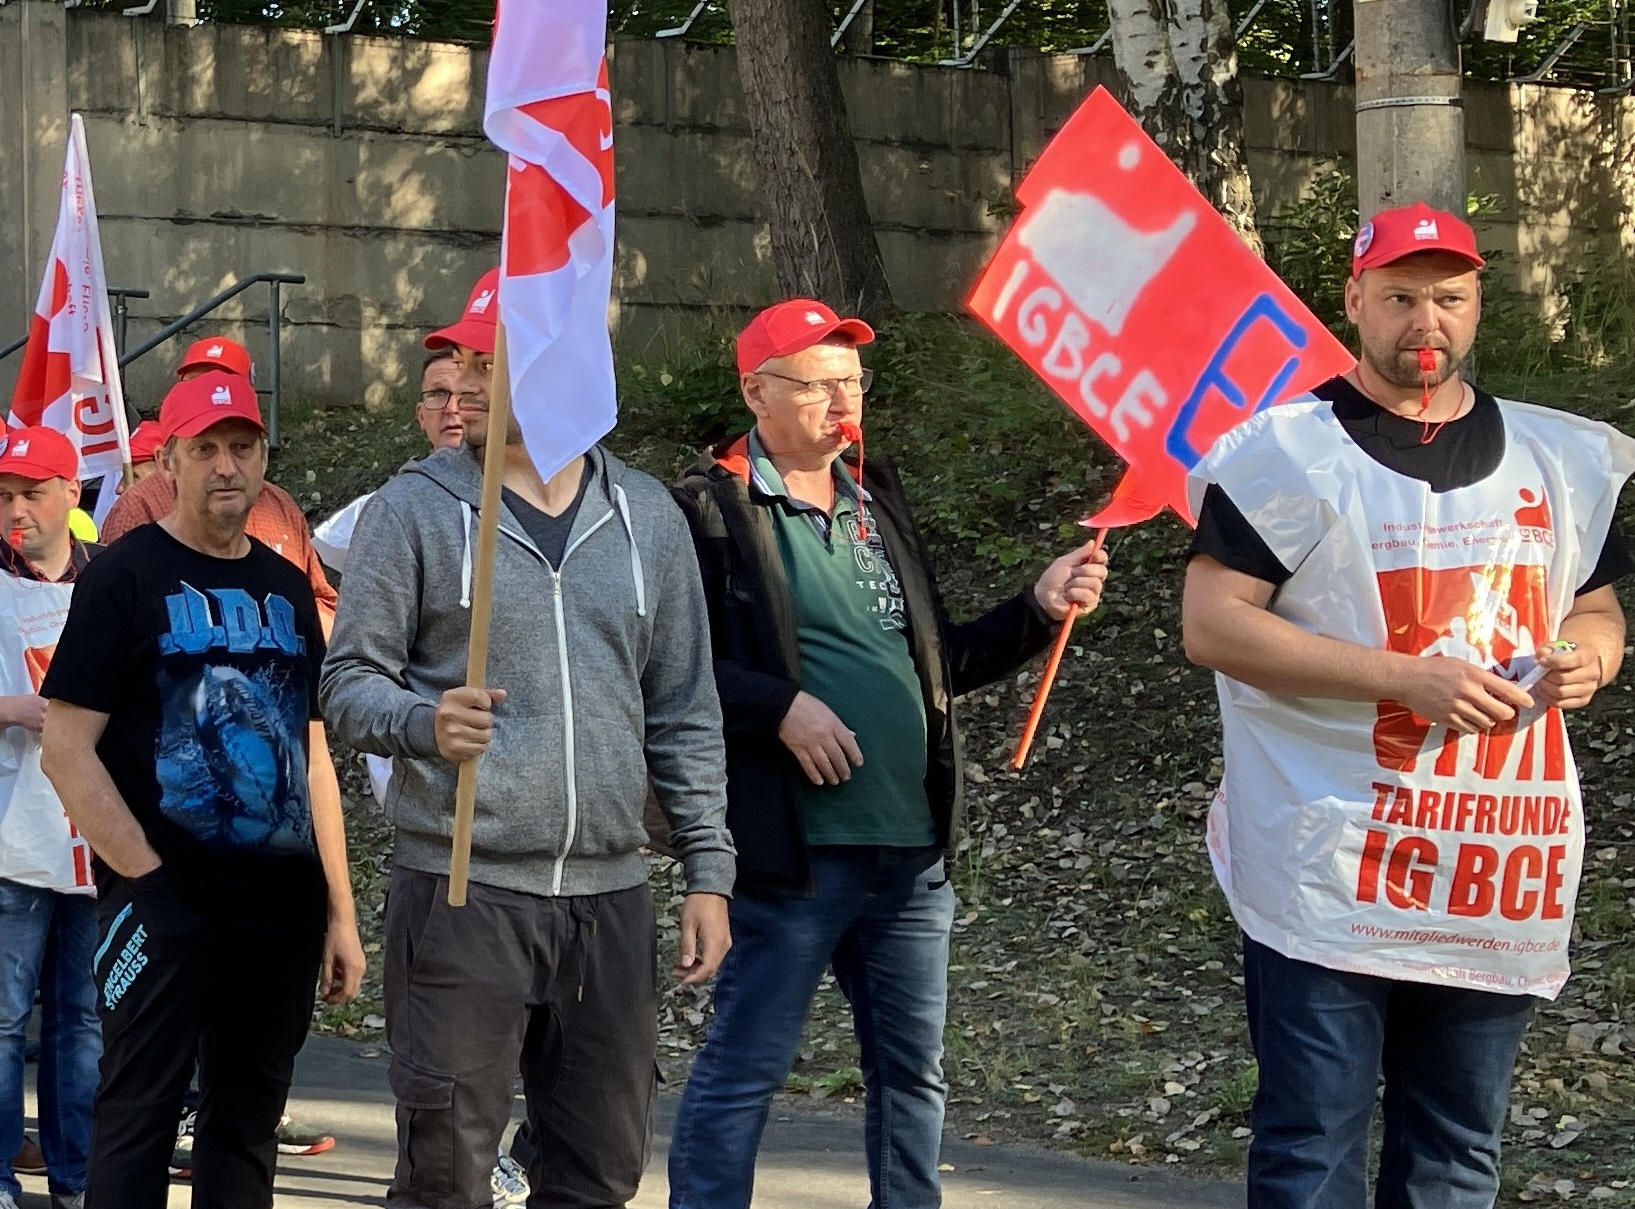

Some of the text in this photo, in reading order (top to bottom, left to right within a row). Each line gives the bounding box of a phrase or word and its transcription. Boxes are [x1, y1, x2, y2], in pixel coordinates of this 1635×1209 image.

[992, 260, 1167, 443] IGBCE
[1371, 782, 1571, 836] TARIFRUNDE
[1355, 828, 1567, 923] IG BCE
[104, 923, 148, 997] ENGELBERT
[106, 951, 149, 1011] STRAUSS
